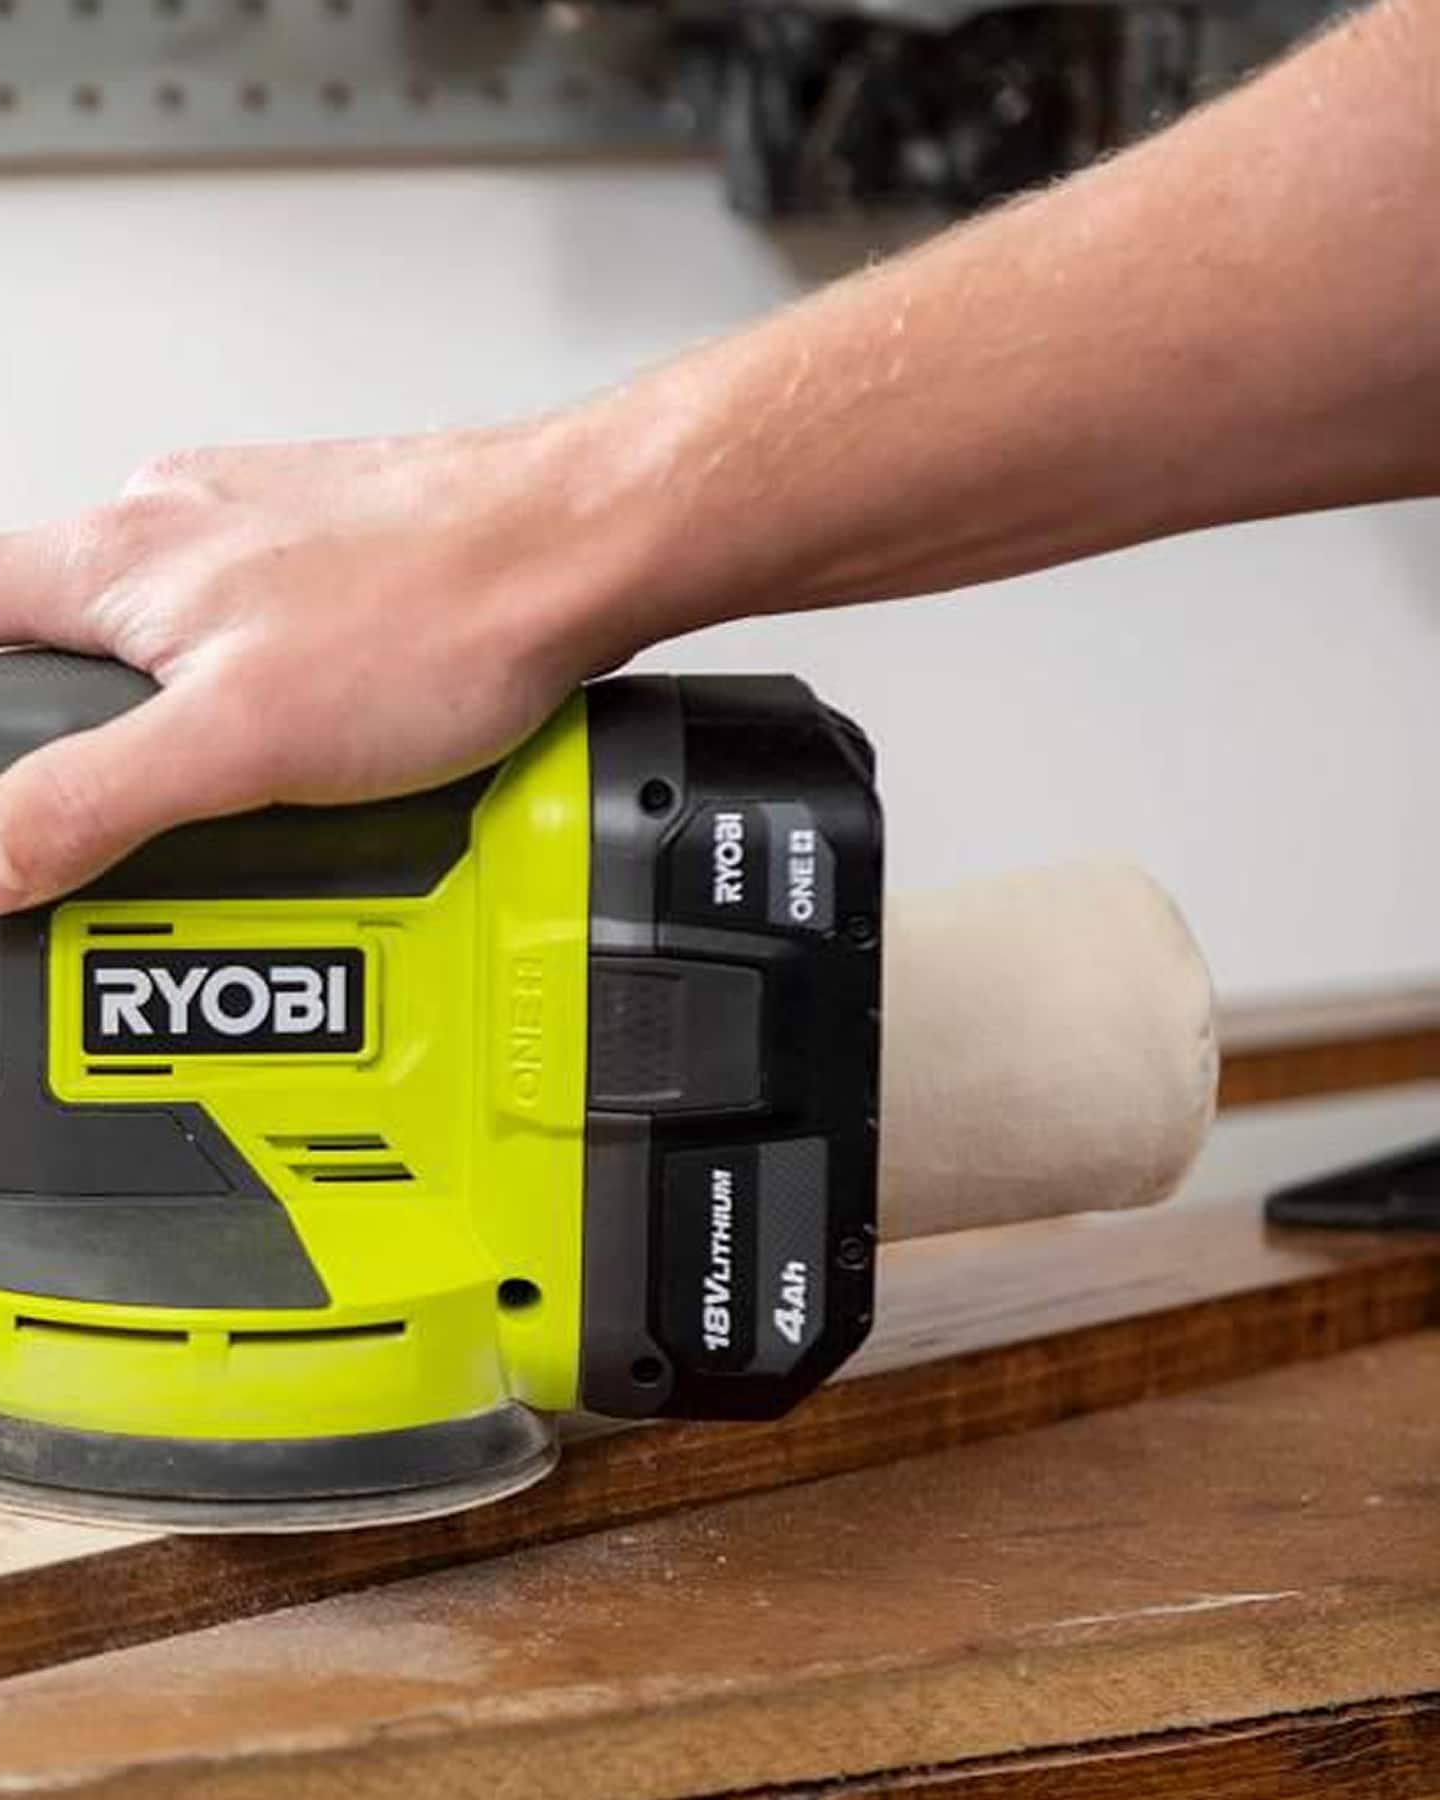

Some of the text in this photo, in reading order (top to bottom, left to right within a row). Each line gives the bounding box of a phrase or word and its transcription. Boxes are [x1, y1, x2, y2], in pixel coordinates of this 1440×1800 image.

[713, 812, 744, 904] RYOBI
[94, 965, 348, 1035] RYOBI
[773, 1260, 807, 1344] 4Ah
